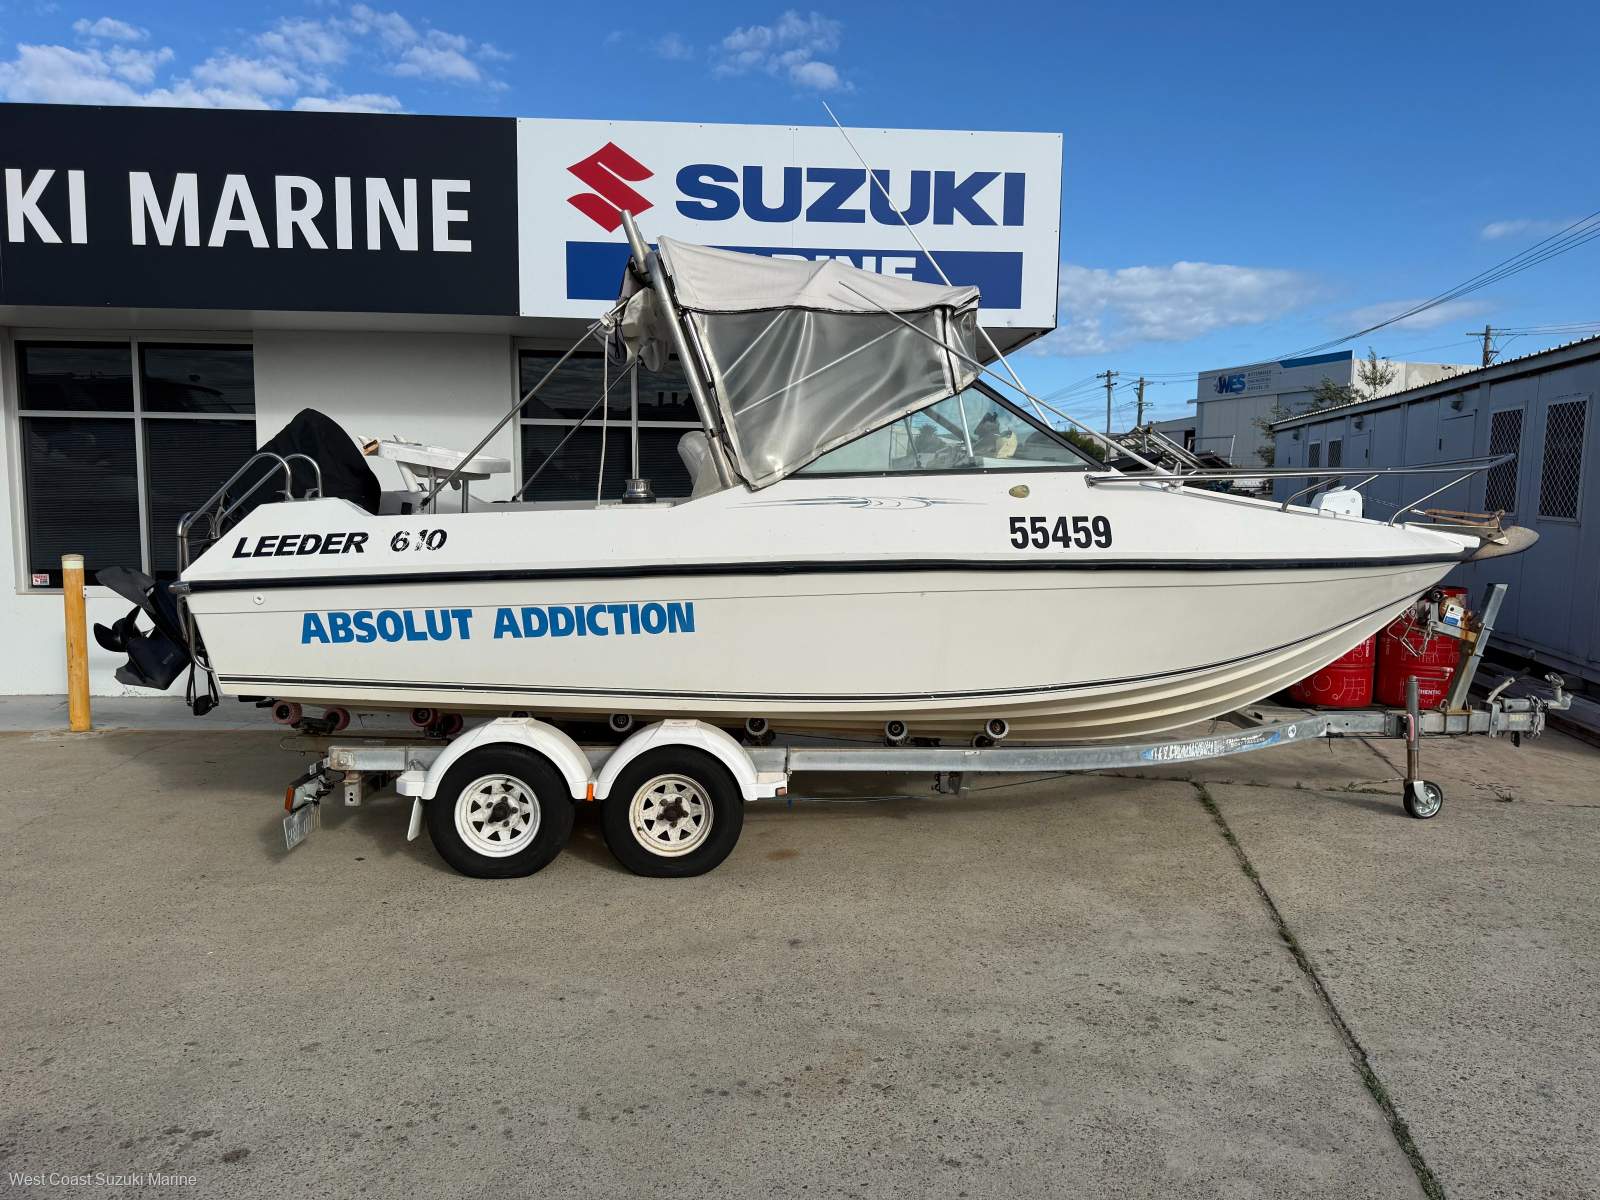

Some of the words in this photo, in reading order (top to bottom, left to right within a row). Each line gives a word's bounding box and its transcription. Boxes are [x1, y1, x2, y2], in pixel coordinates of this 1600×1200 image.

[129, 171, 473, 253] MARINE
[675, 163, 1025, 227] SUZUKI
[232, 531, 370, 559] LEEDER
[1009, 515, 1113, 549] 55459
[301, 609, 473, 645] ABSOLUT
[493, 602, 696, 640] ADDICTION
